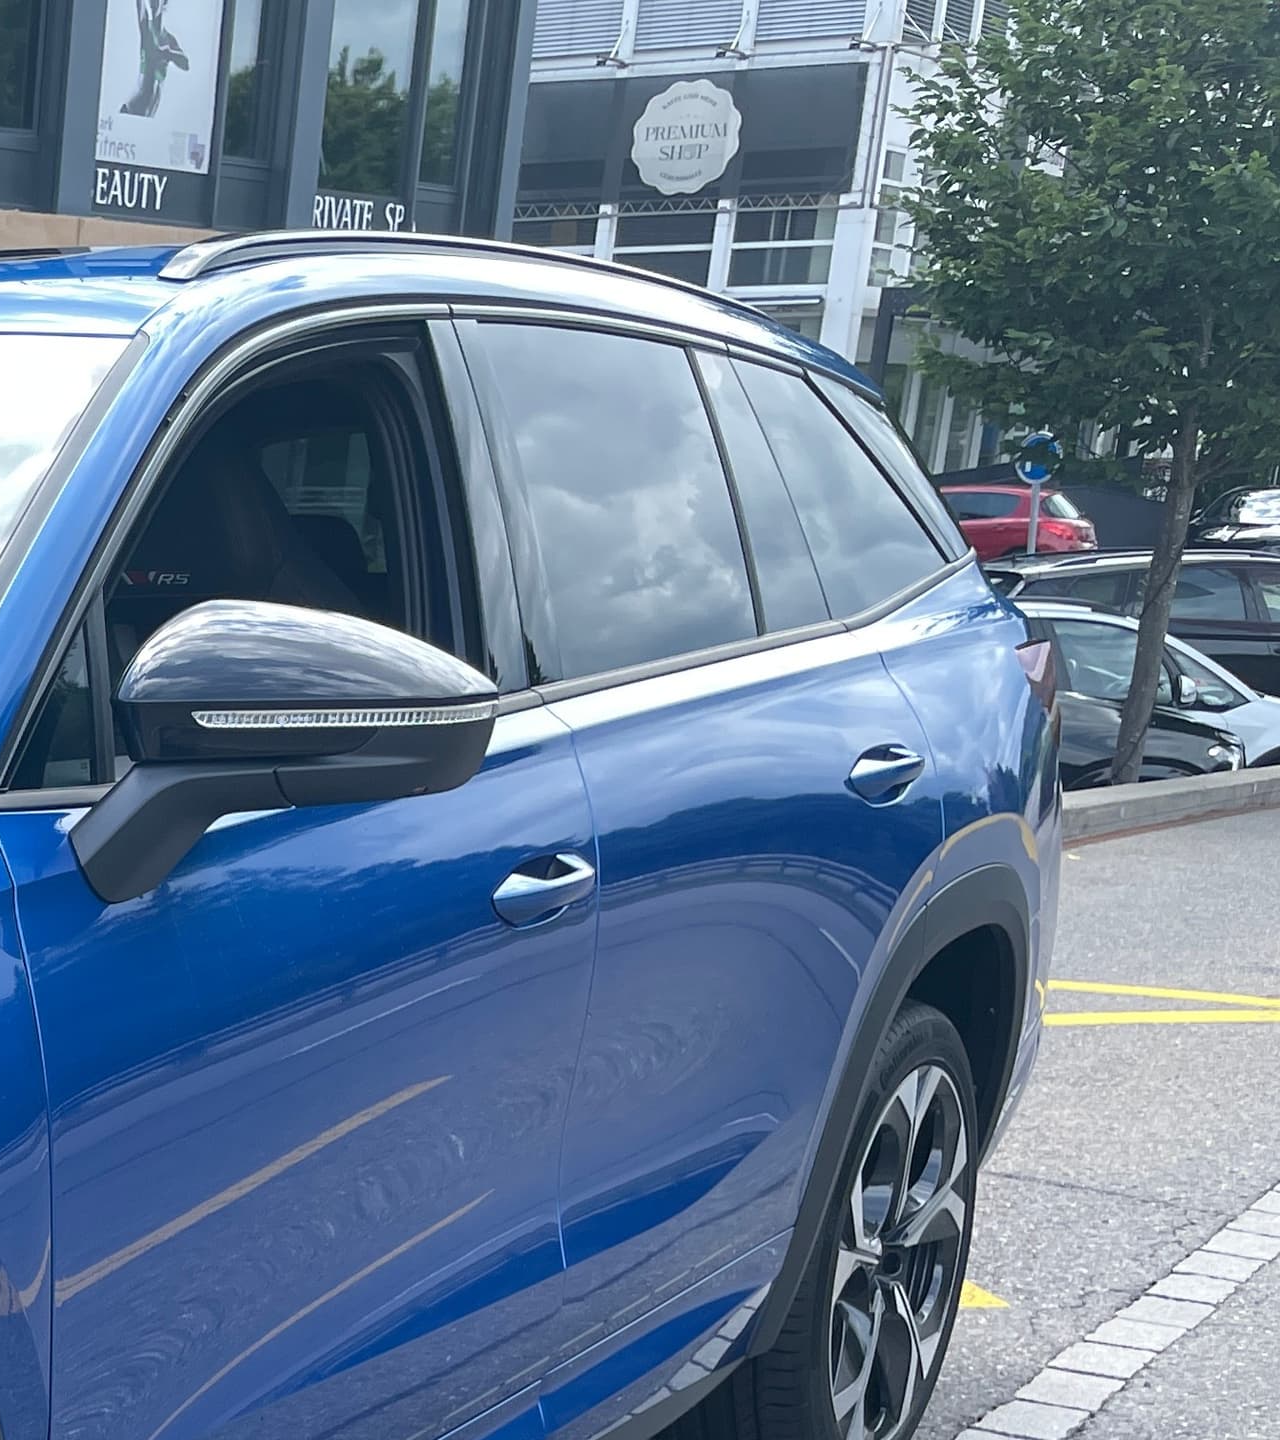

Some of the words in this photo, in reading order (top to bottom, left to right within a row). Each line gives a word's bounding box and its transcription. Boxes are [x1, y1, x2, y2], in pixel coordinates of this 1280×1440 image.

[644, 123, 728, 141] PREMIUM
[659, 143, 709, 160] SHOP
[92, 167, 168, 210] EAUTY
[385, 202, 416, 232] SP
